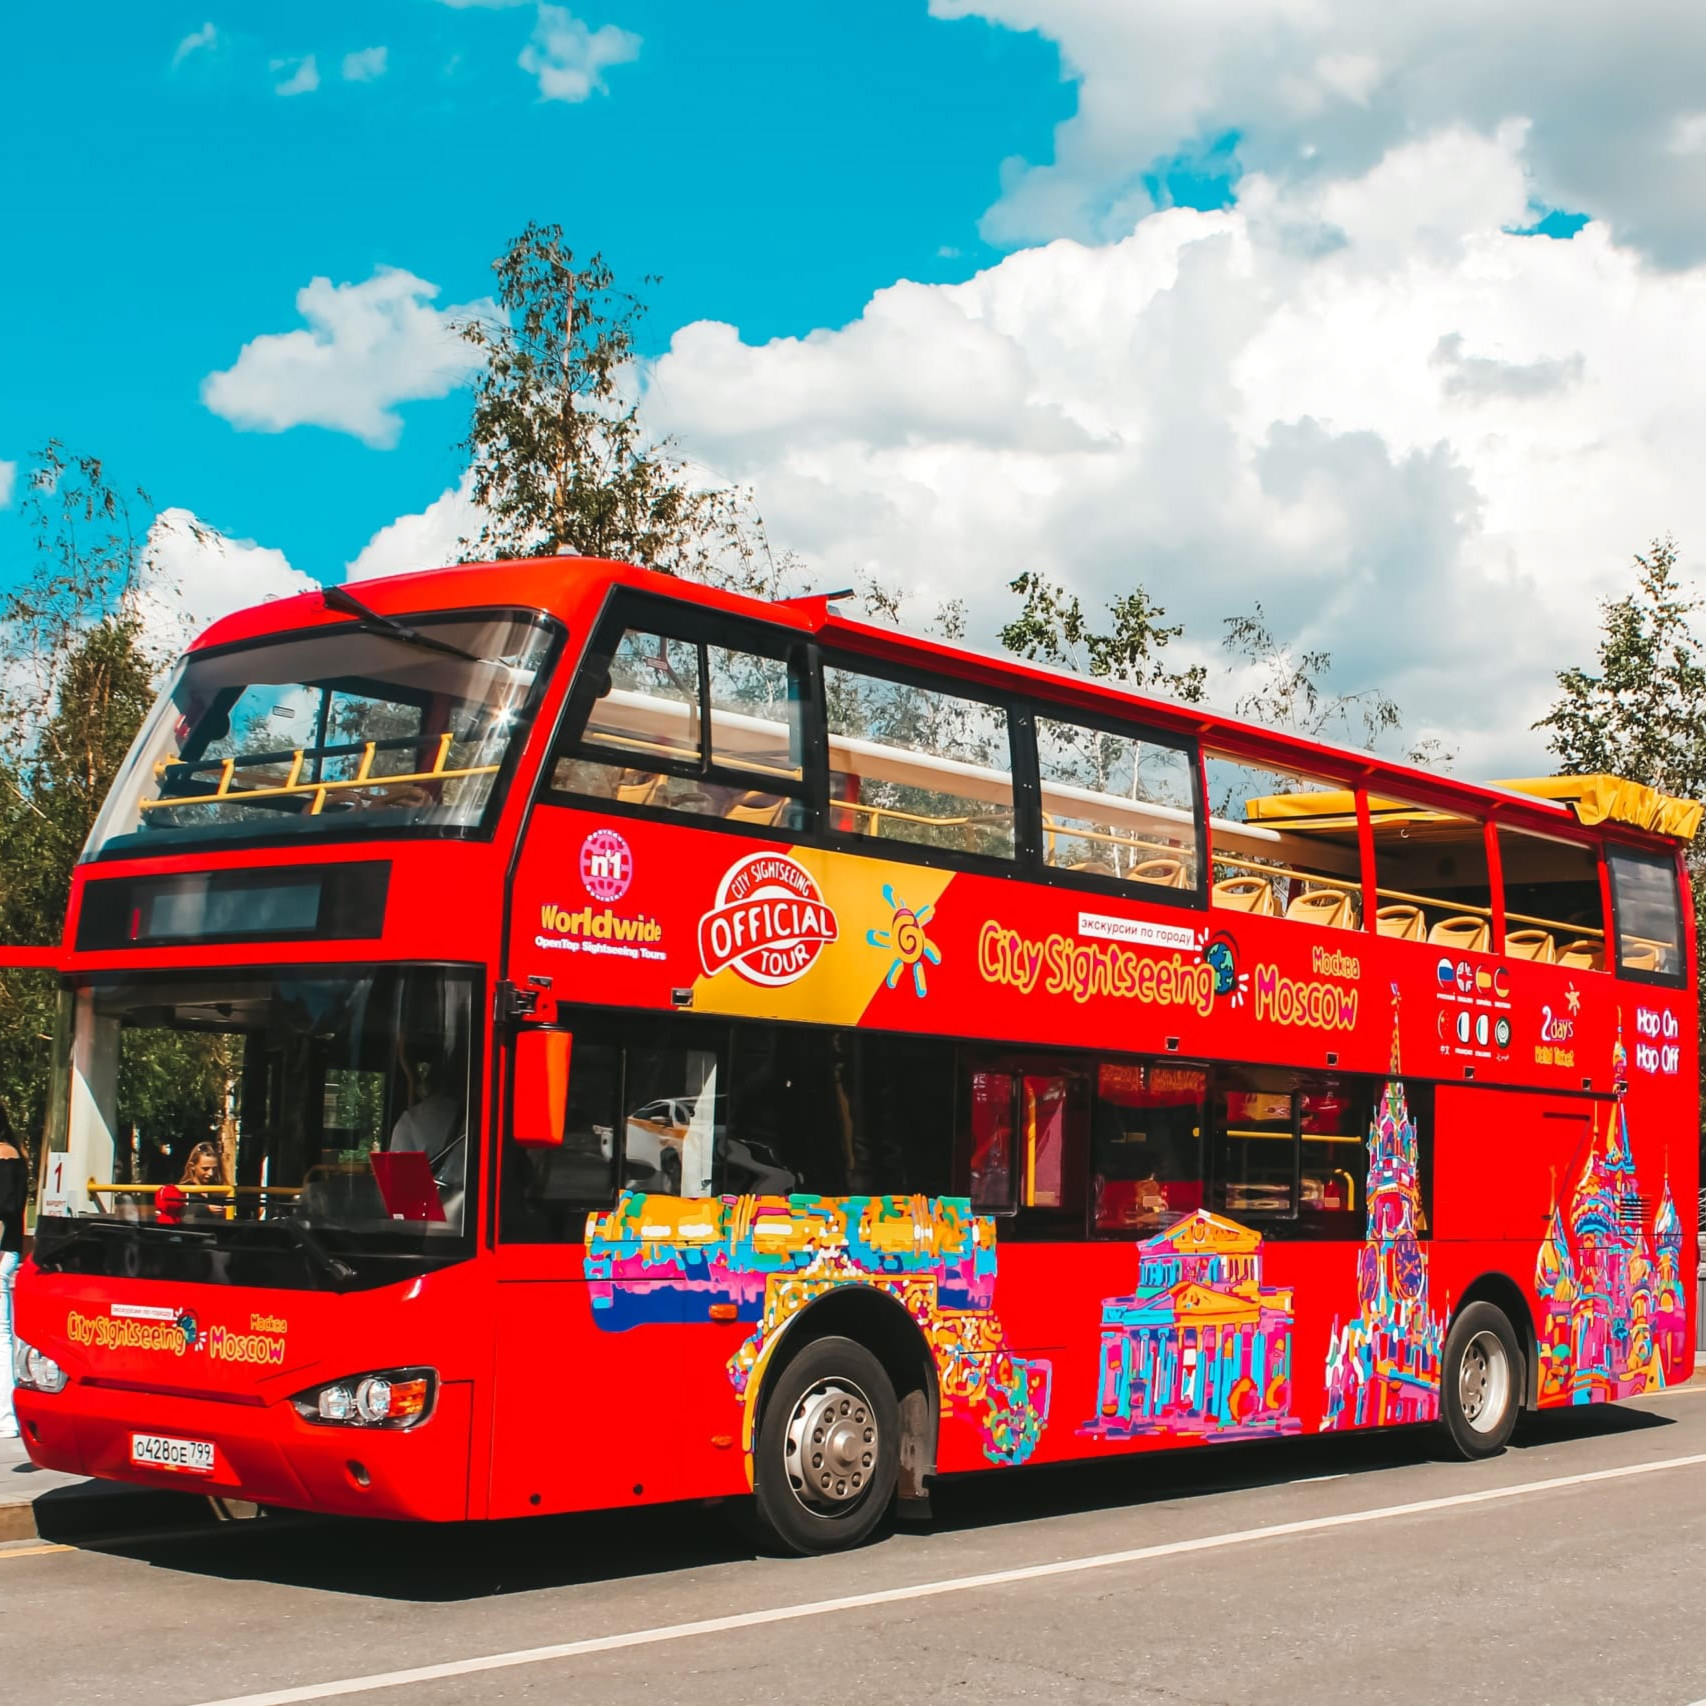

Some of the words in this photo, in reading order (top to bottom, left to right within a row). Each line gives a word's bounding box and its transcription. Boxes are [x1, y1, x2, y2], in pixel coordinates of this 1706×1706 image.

[731, 872, 751, 899] CITY
[750, 861, 812, 897] SIGHTSEEING
[541, 905, 662, 942] Worldwide
[711, 903, 833, 958] OFFICIAL
[1081, 919, 1138, 935] экскурсии
[1140, 927, 1154, 938] по
[1156, 930, 1192, 946] городу
[761, 943, 810, 975] TOUR
[1045, 934, 1216, 1017] Sightseeing
[1541, 1005, 1552, 1041] 2
[1551, 1018, 1574, 1041] days
[1637, 1008, 1660, 1038] Hop
[1663, 1010, 1679, 1038] On
[1637, 1043, 1660, 1073] Hop
[1662, 1045, 1680, 1073] Off
[54, 1161, 63, 1194] 1
[190, 1442, 211, 1460] 799
